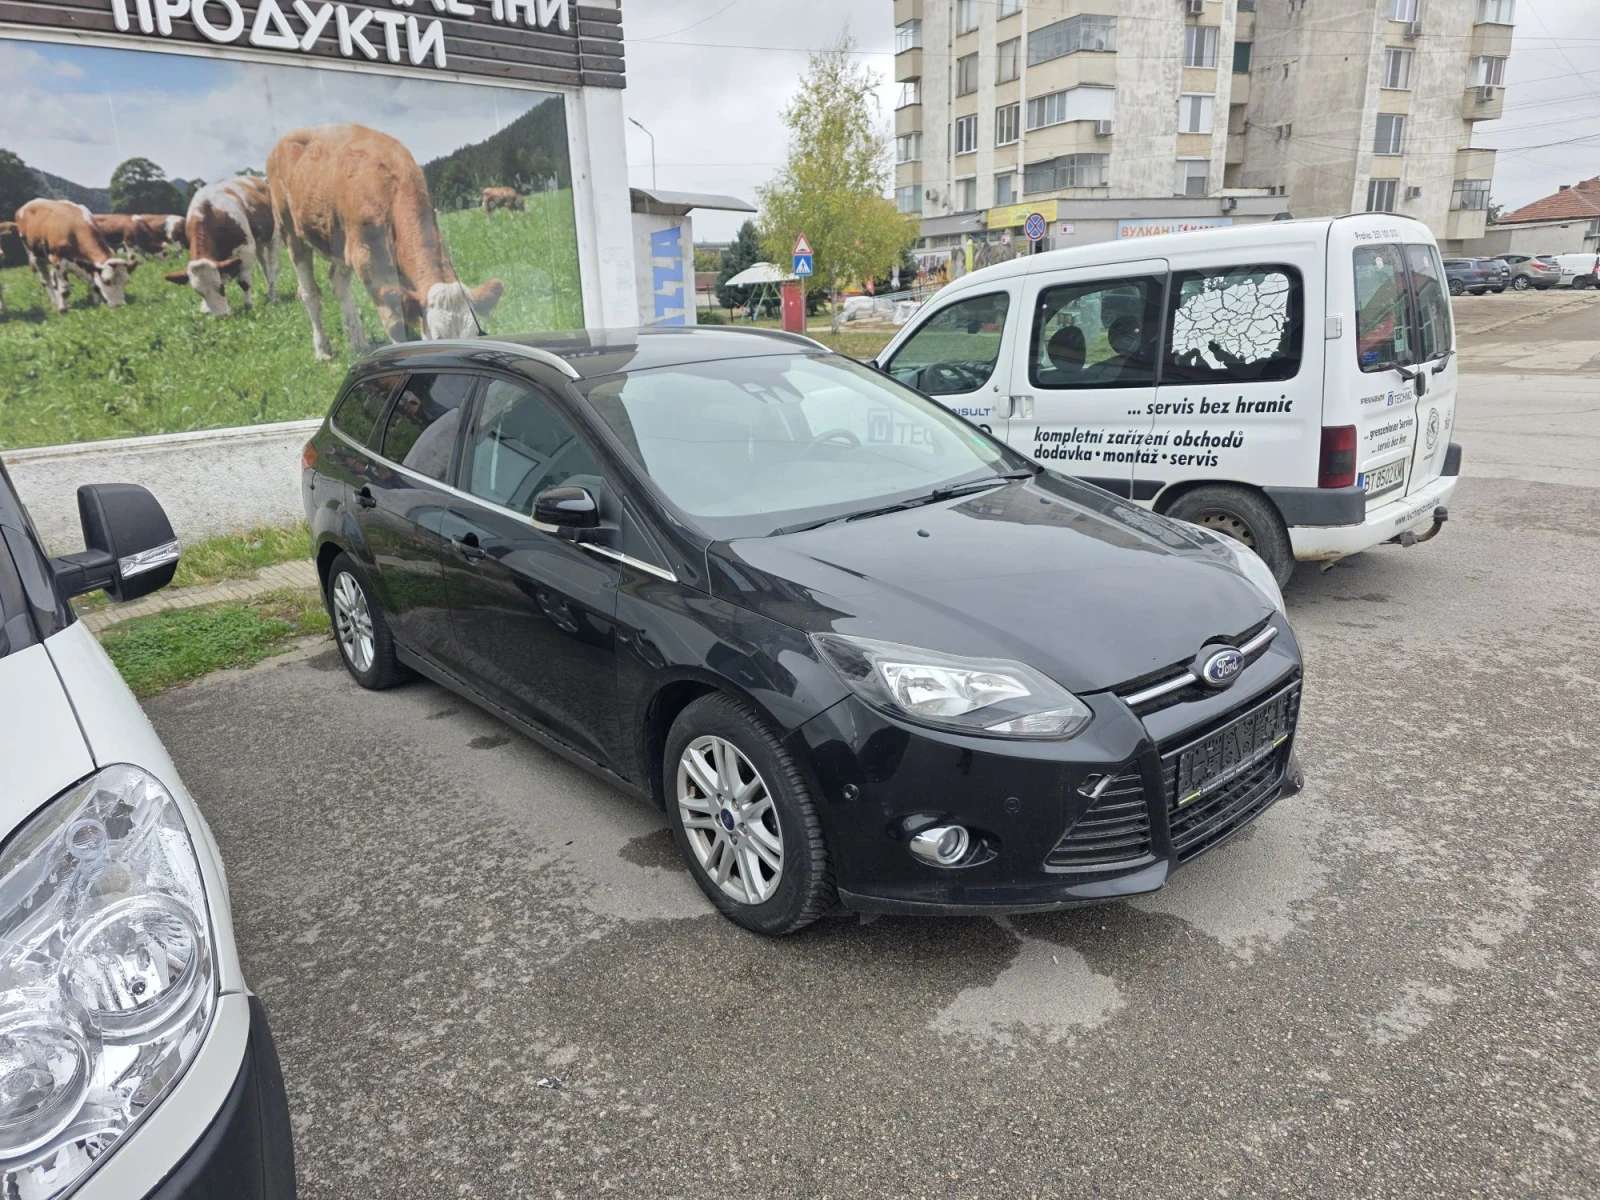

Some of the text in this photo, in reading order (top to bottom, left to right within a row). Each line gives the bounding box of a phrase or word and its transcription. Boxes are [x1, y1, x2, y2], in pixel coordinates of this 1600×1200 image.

[111, 0, 446, 69] ПРОДУКТИ
[1146, 397, 1194, 415] servis
[1199, 396, 1231, 414] bez
[1235, 394, 1293, 413] hranic
[1033, 426, 1244, 448] kompletní zařízení obchodů
[1033, 443, 1219, 467] dodávka montáž servis
[1216, 656, 1239, 677] Ford
